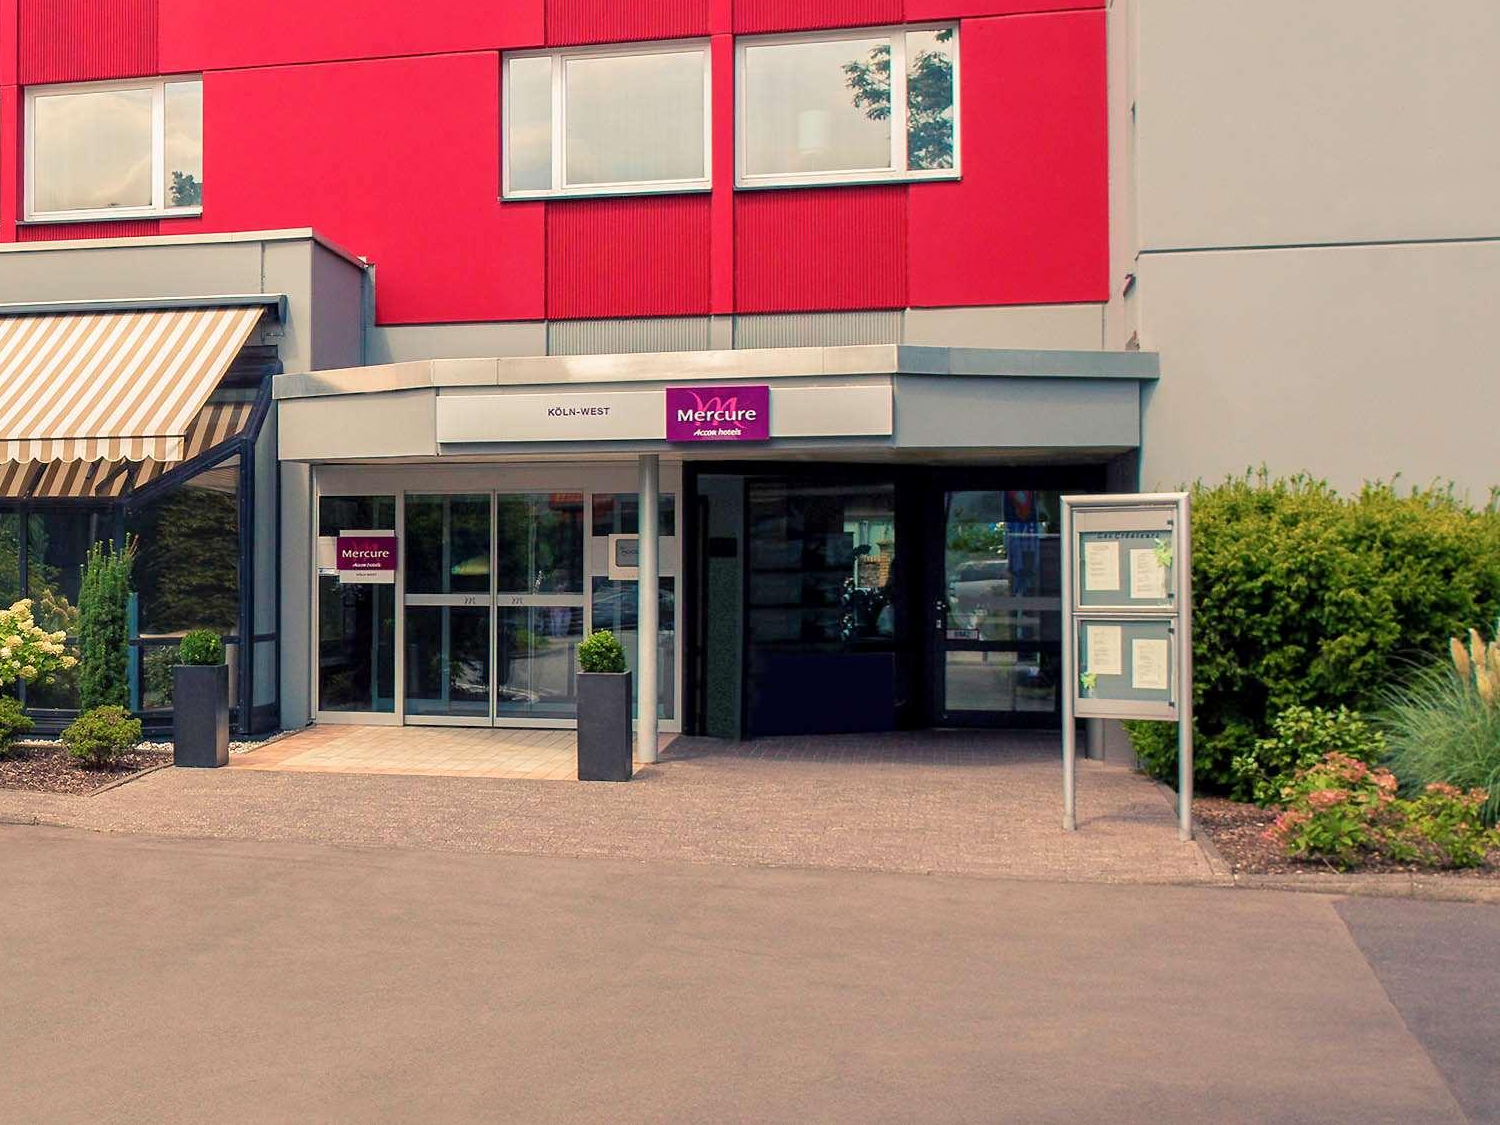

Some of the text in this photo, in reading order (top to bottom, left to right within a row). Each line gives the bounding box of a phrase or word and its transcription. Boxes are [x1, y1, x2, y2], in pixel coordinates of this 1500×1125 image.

[547, 407, 611, 417] KÖLN-WEST
[677, 409, 757, 422] Mercure
[718, 427, 742, 436] hotels
[341, 549, 390, 558] Mercure
